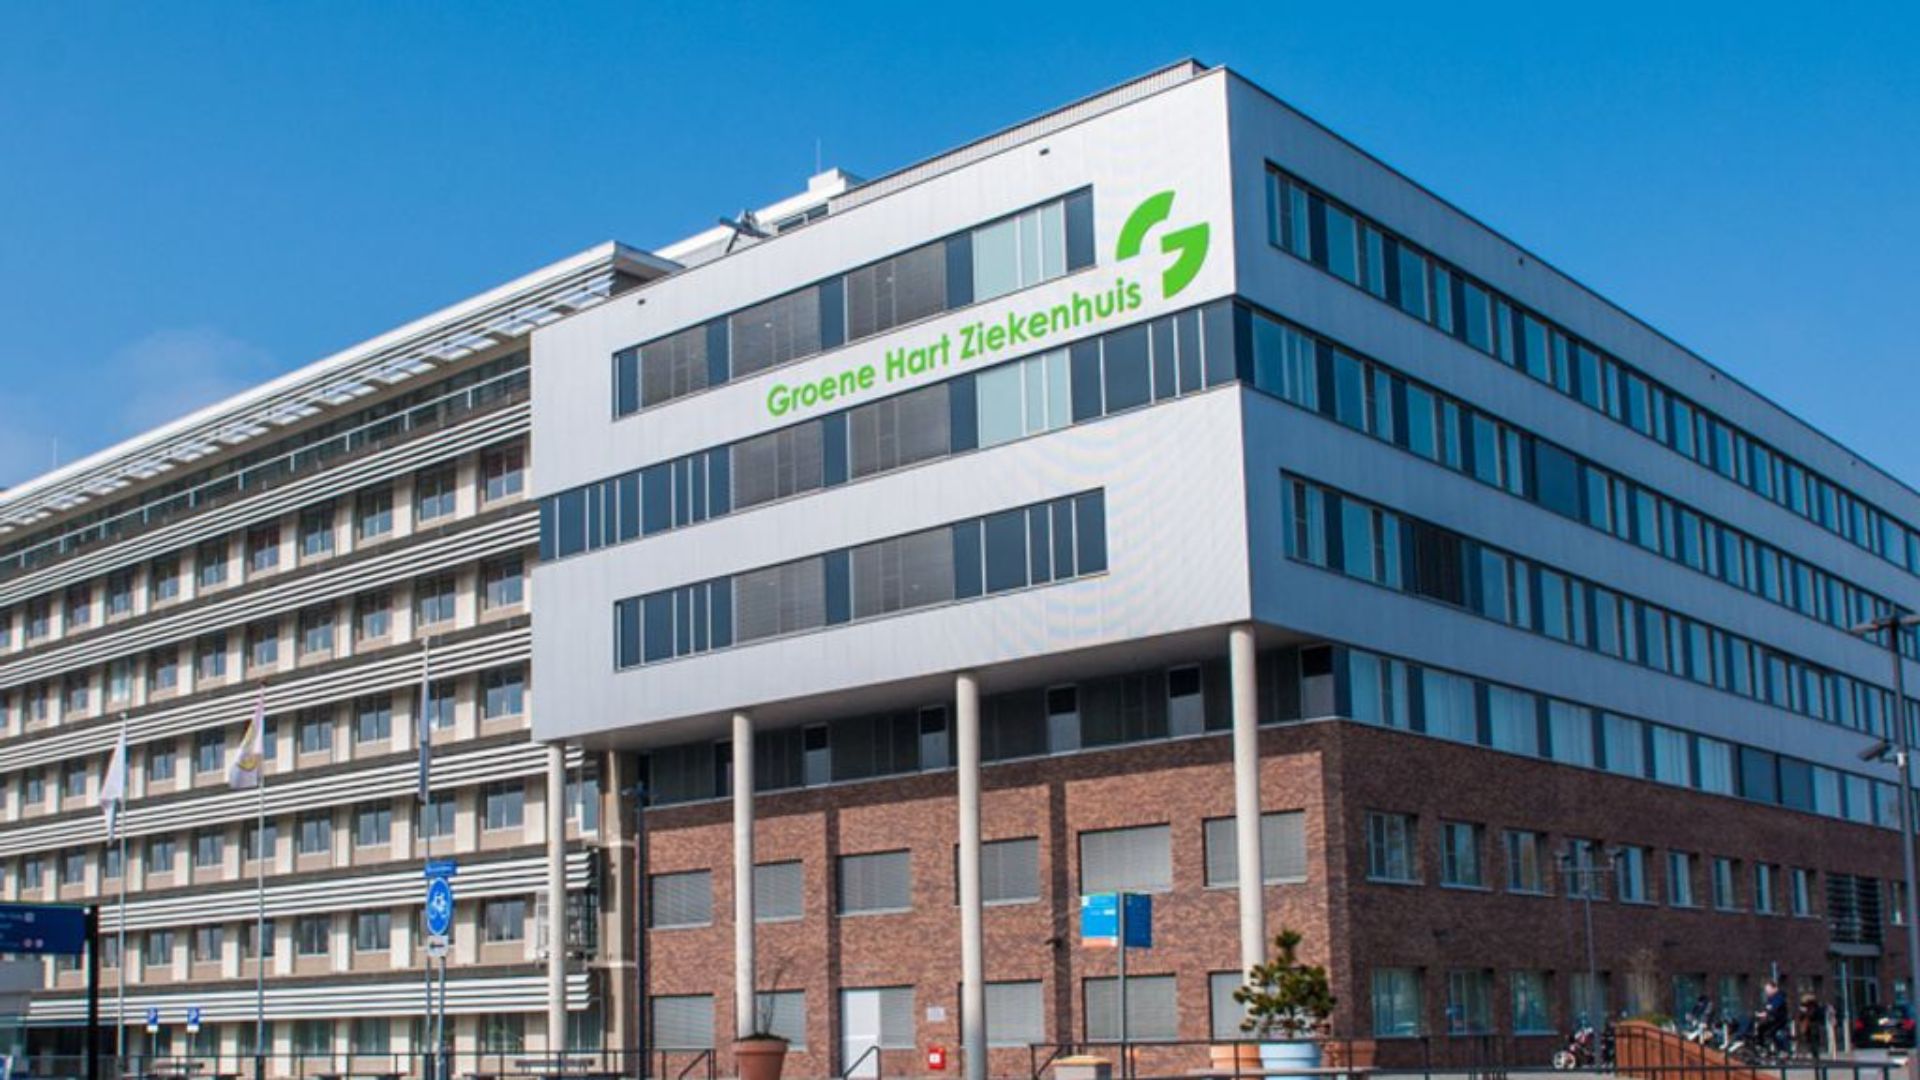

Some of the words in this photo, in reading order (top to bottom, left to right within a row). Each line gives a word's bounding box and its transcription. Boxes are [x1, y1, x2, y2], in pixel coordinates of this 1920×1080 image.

[767, 364, 876, 417] Groene
[885, 334, 951, 382] Hart
[959, 278, 1142, 359] Ziekenhuis
